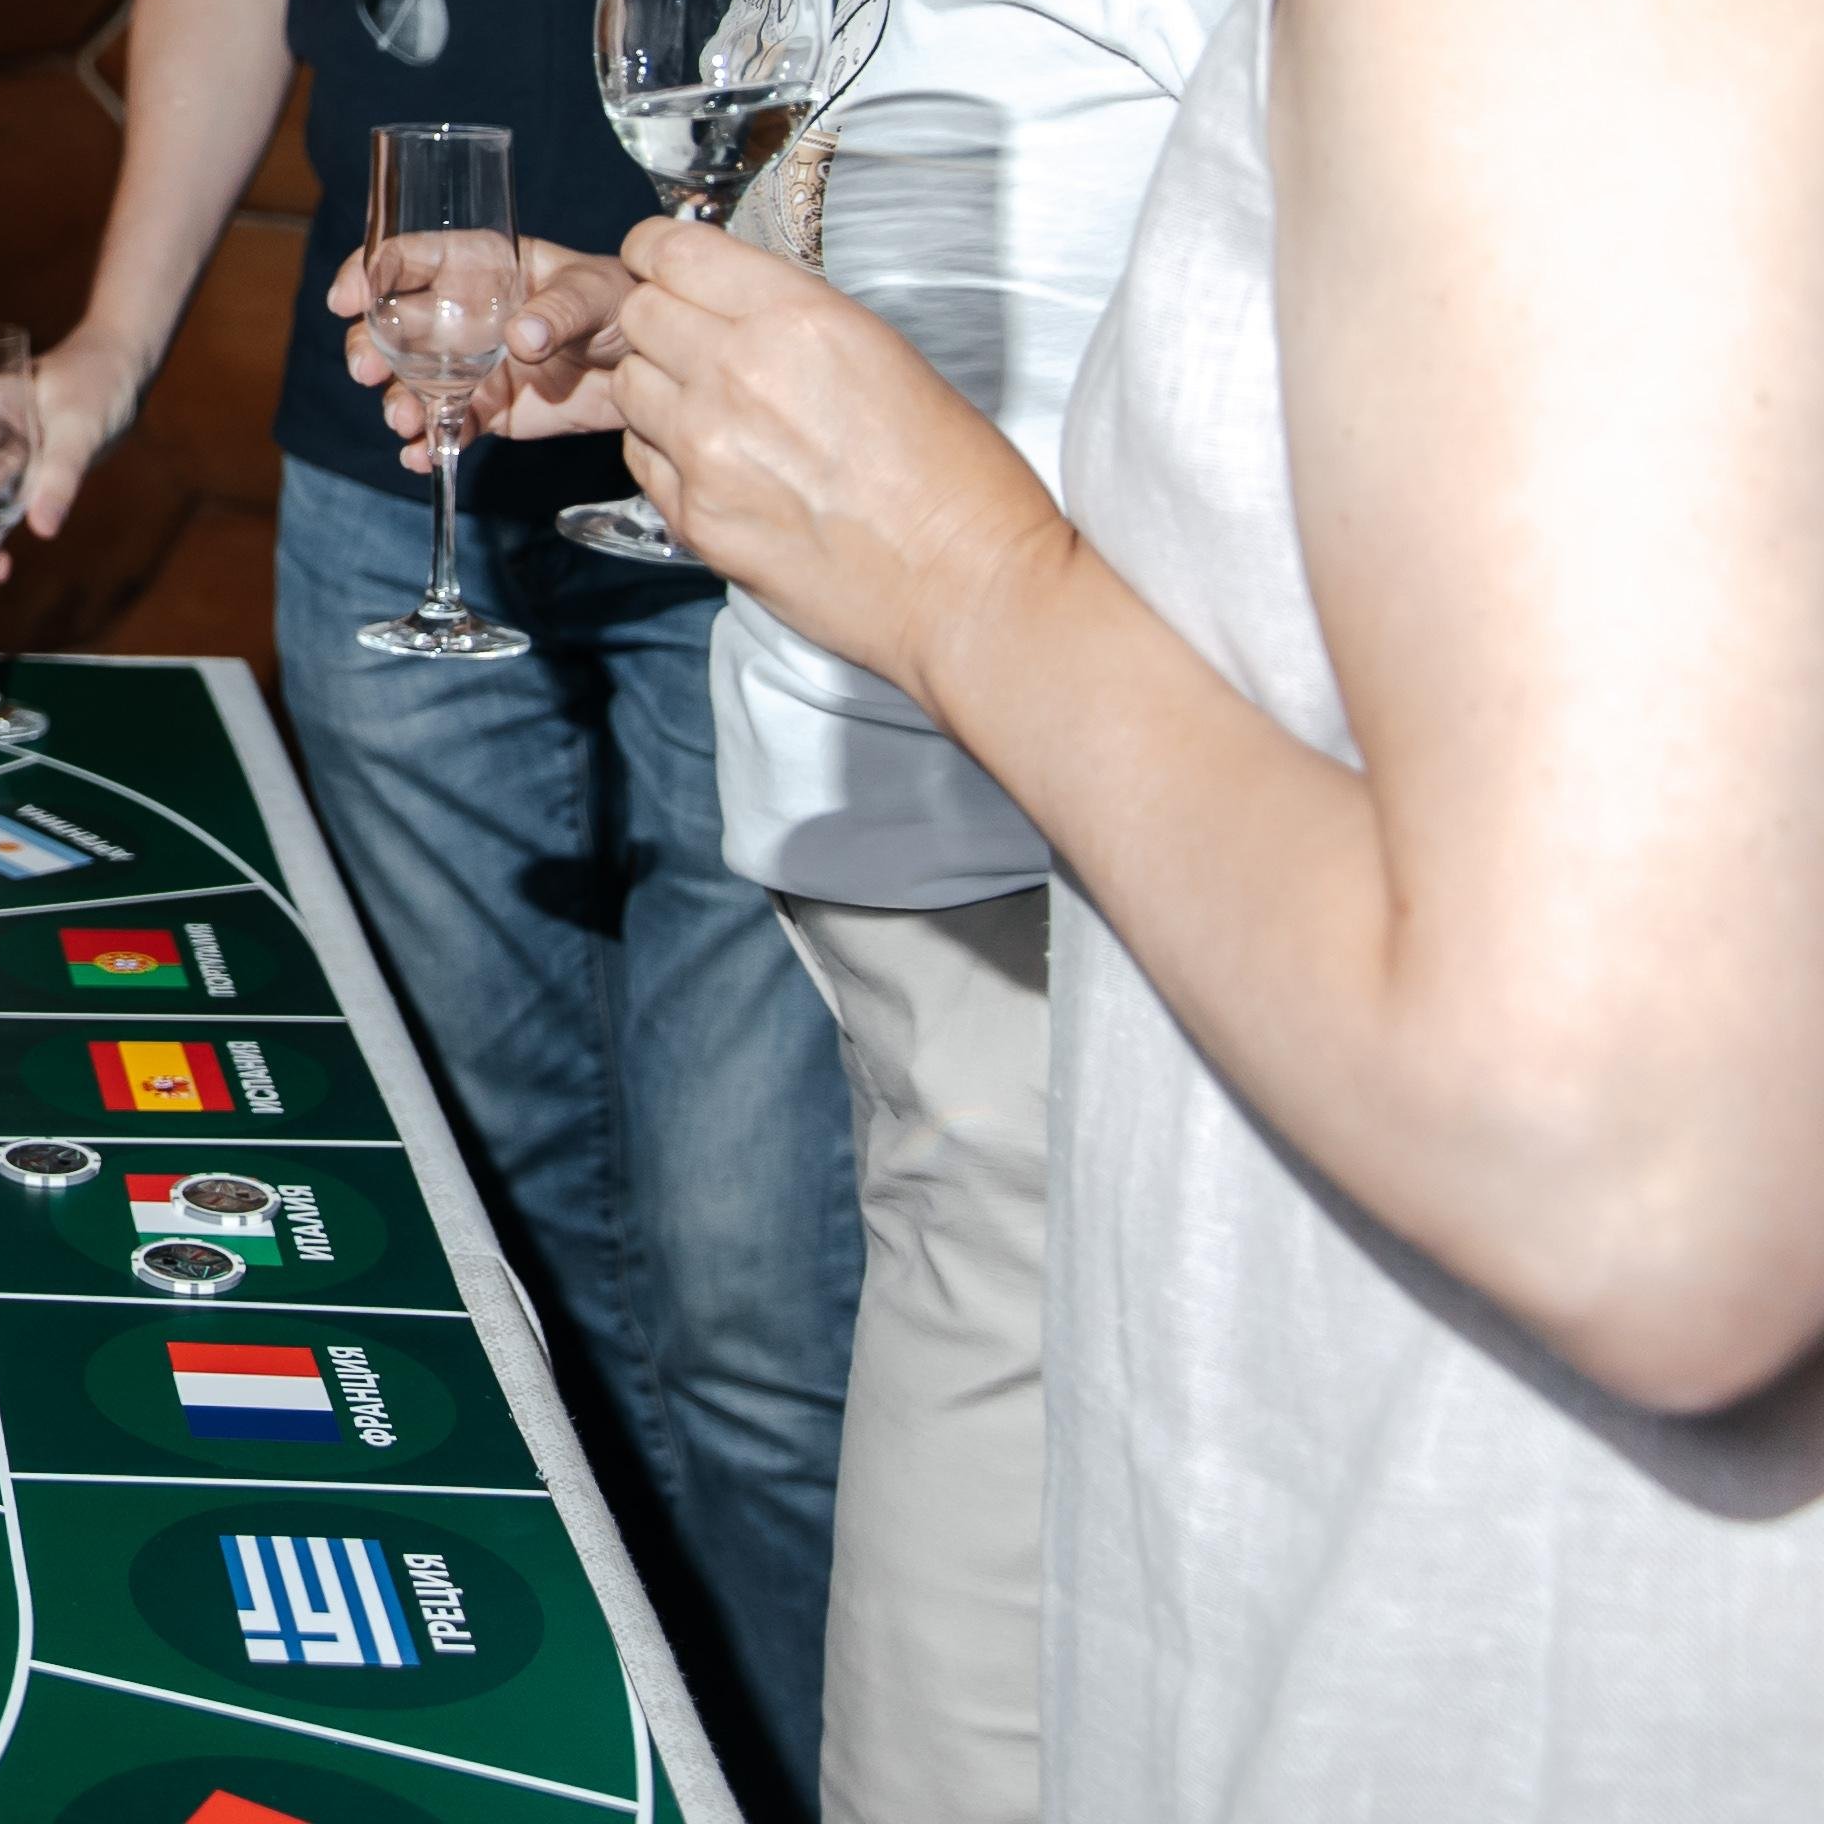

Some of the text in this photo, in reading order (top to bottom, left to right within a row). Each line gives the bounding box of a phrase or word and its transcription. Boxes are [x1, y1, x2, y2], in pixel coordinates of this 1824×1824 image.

[183, 923, 237, 998] ПОРТУГАЛИЯ
[225, 1040, 285, 1115] ИСПАНИЯ
[276, 1184, 335, 1261] ИТАЛИЯ
[327, 1346, 398, 1448] ФРАНЦИЯ
[402, 1553, 477, 1654] ГРЕЦИЯ
